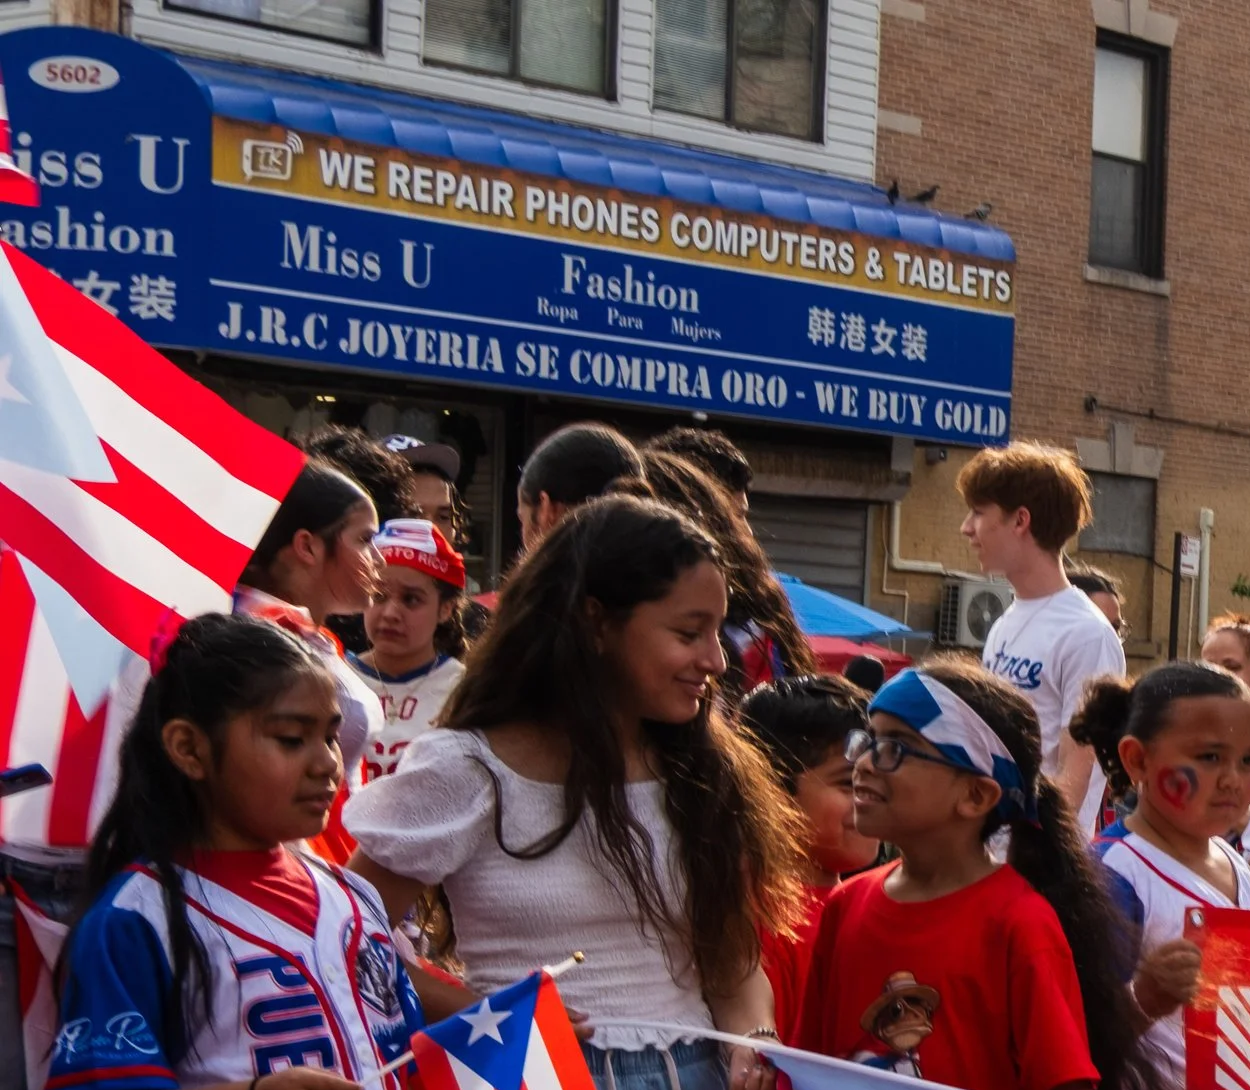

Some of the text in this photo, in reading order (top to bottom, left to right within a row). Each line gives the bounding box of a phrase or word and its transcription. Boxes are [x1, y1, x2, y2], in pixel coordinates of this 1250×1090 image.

[46, 63, 101, 86] 5602
[13, 131, 191, 194] iss U
[0, 206, 177, 257] ashion
[319, 147, 1012, 302] WE REPAIR PHONES COMPUTERS & TABLETS
[280, 220, 434, 289] Miss U
[560, 252, 700, 313] Fashion
[50, 268, 177, 322] 女装
[537, 296, 722, 342] Ropa Para Mujers
[807, 305, 928, 363] 韩港女装
[218, 301, 328, 352] J.R.C
[338, 319, 505, 377] JOYERIA
[516, 341, 560, 381] SE
[570, 350, 711, 401] COMPRA
[722, 369, 788, 408] ORO
[814, 381, 858, 419] WE
[868, 388, 927, 428] BUY
[935, 400, 1007, 438] GOLD
[381, 546, 449, 574] RTO RICO
